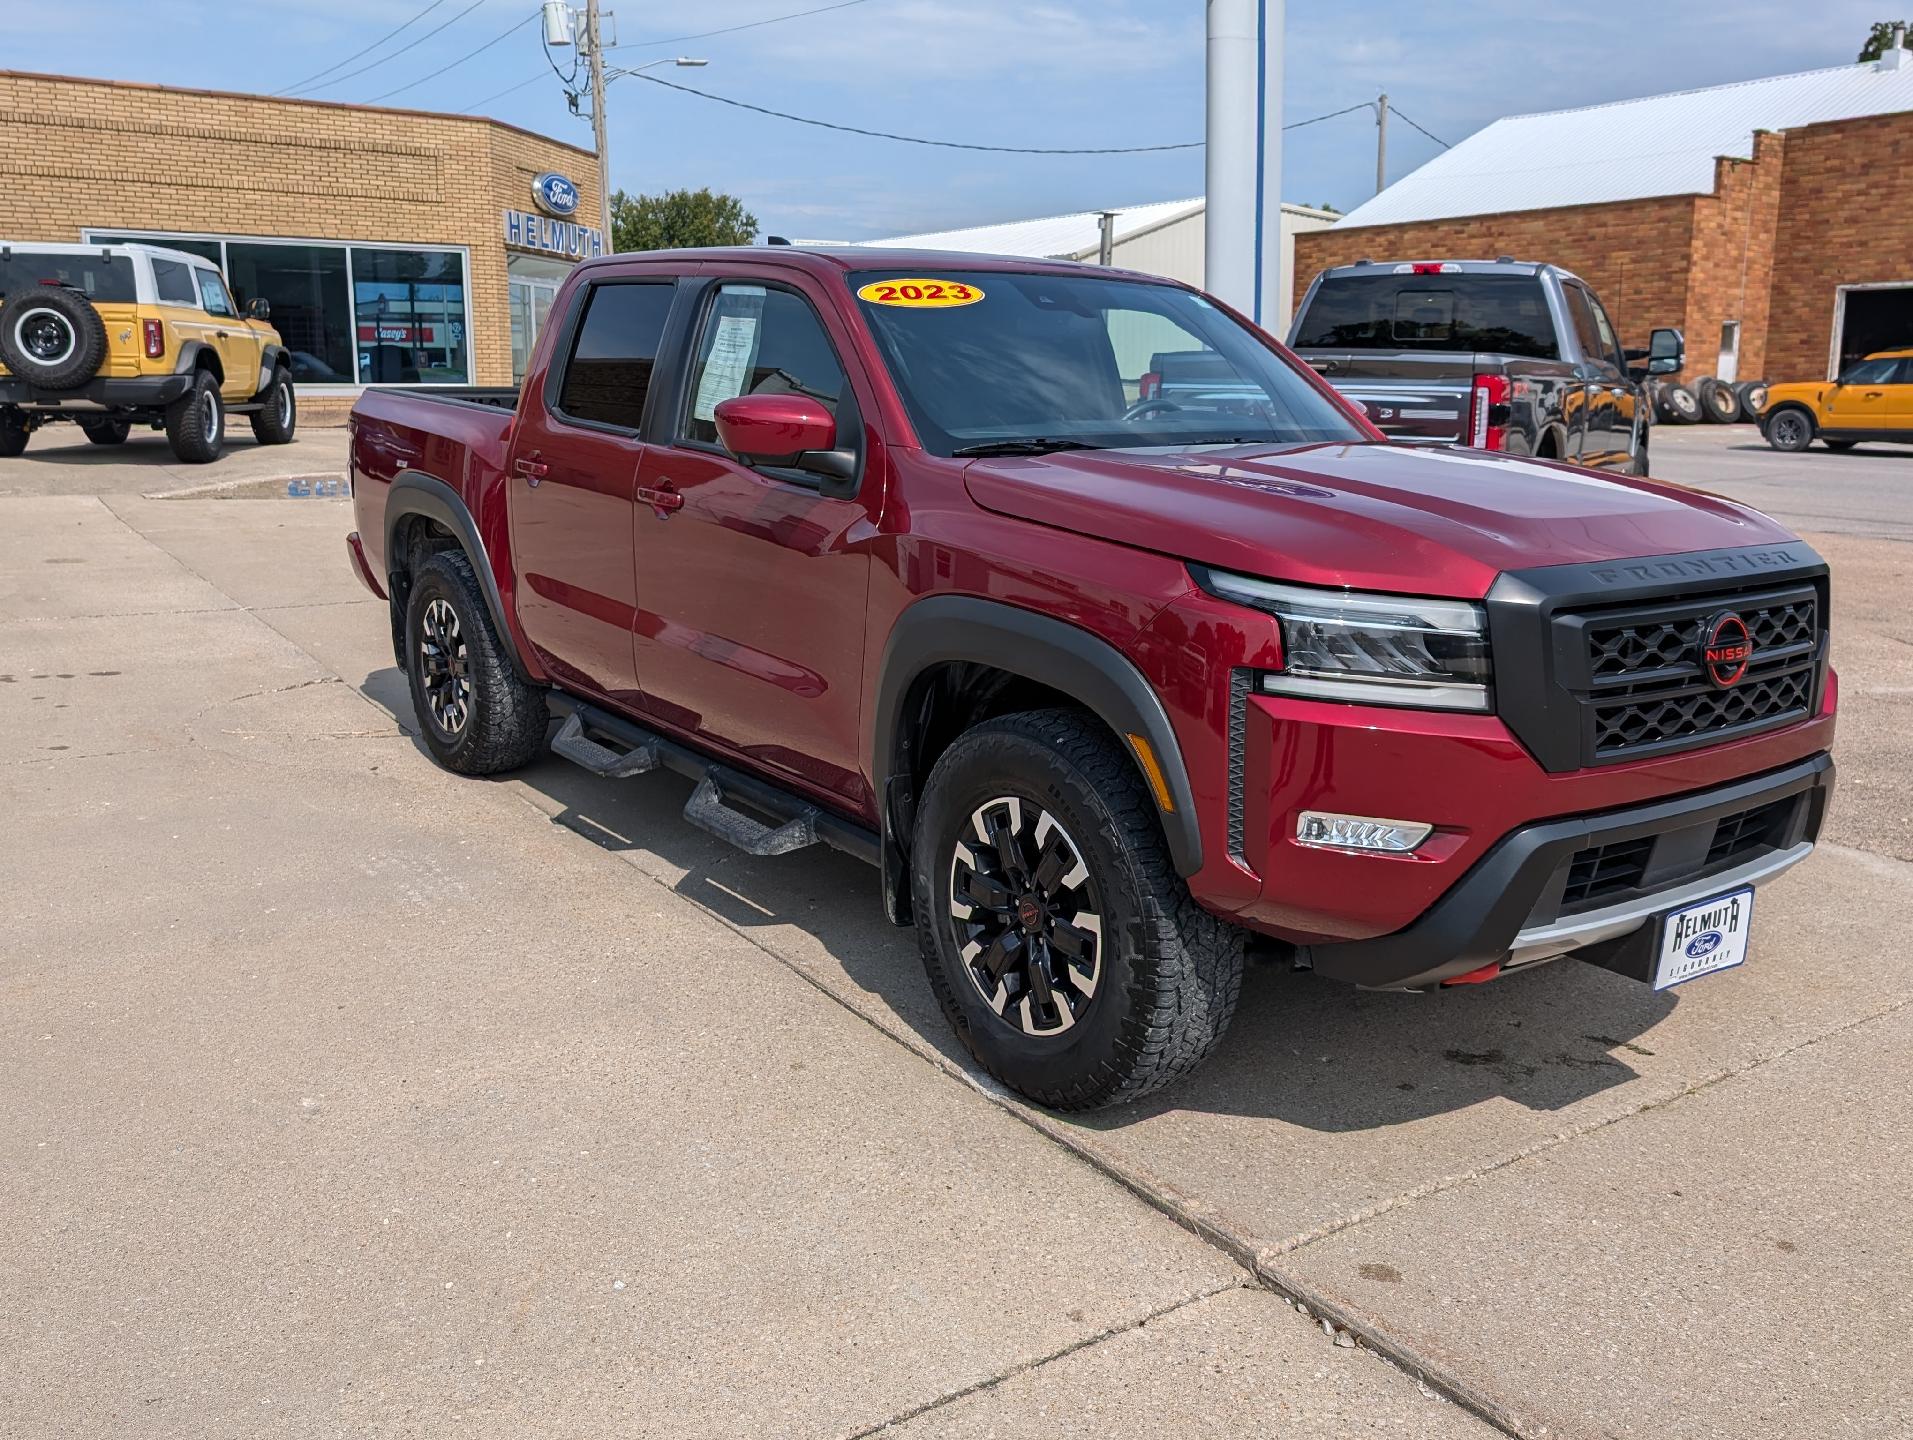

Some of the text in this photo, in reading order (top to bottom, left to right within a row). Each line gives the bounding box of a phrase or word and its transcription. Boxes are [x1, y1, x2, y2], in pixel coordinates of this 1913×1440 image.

[550, 180, 575, 207] Ford
[508, 211, 603, 258] HELMUTH
[875, 284, 974, 301] 2023
[1590, 551, 1799, 585] FRONTIER
[1706, 646, 1751, 661] NISSA
[1672, 898, 1740, 953] HELMUTH
[1691, 935, 1717, 955] Ford
